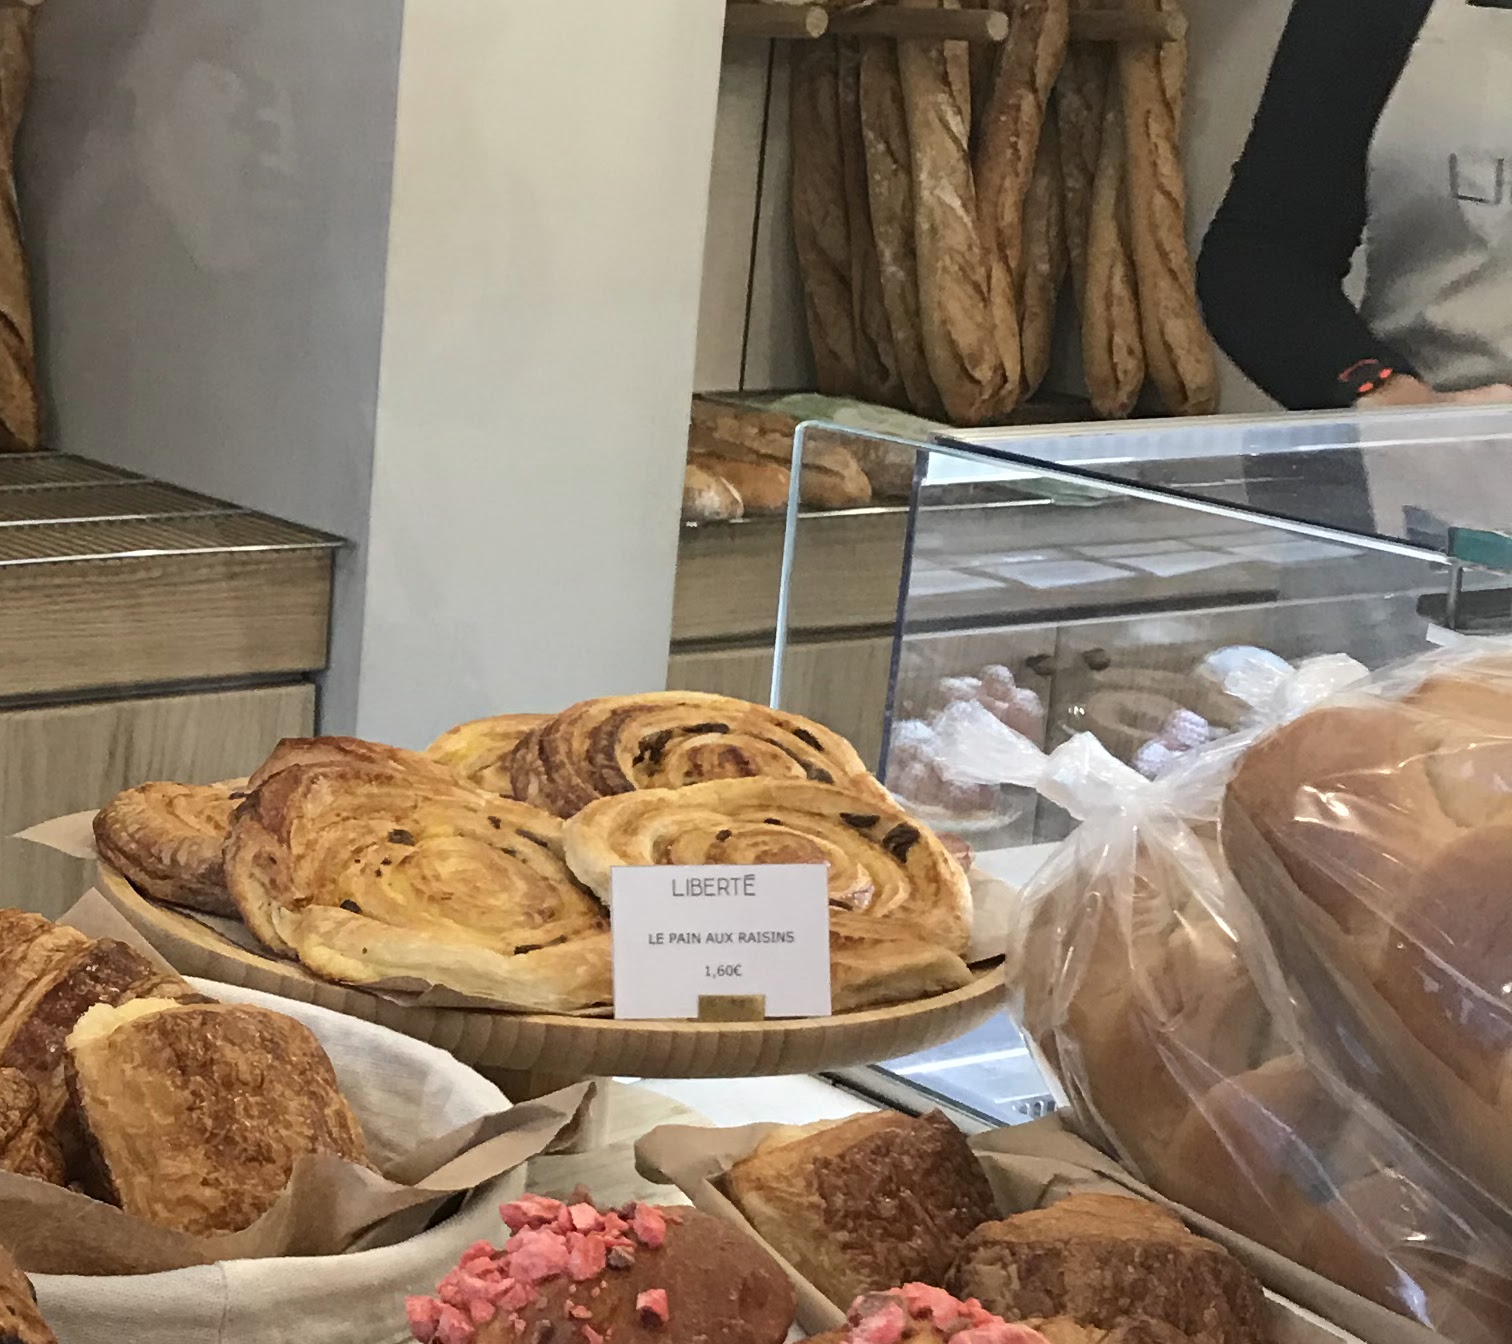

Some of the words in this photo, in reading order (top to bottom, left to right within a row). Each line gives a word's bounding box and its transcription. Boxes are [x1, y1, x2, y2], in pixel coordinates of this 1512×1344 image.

[672, 874, 756, 897] LIBERTÉ
[649, 933, 664, 945] LE
[669, 932, 701, 944] PAIN
[706, 932, 733, 943] AUX
[738, 931, 795, 943] RAISINS
[705, 965, 742, 978] 1,60€
